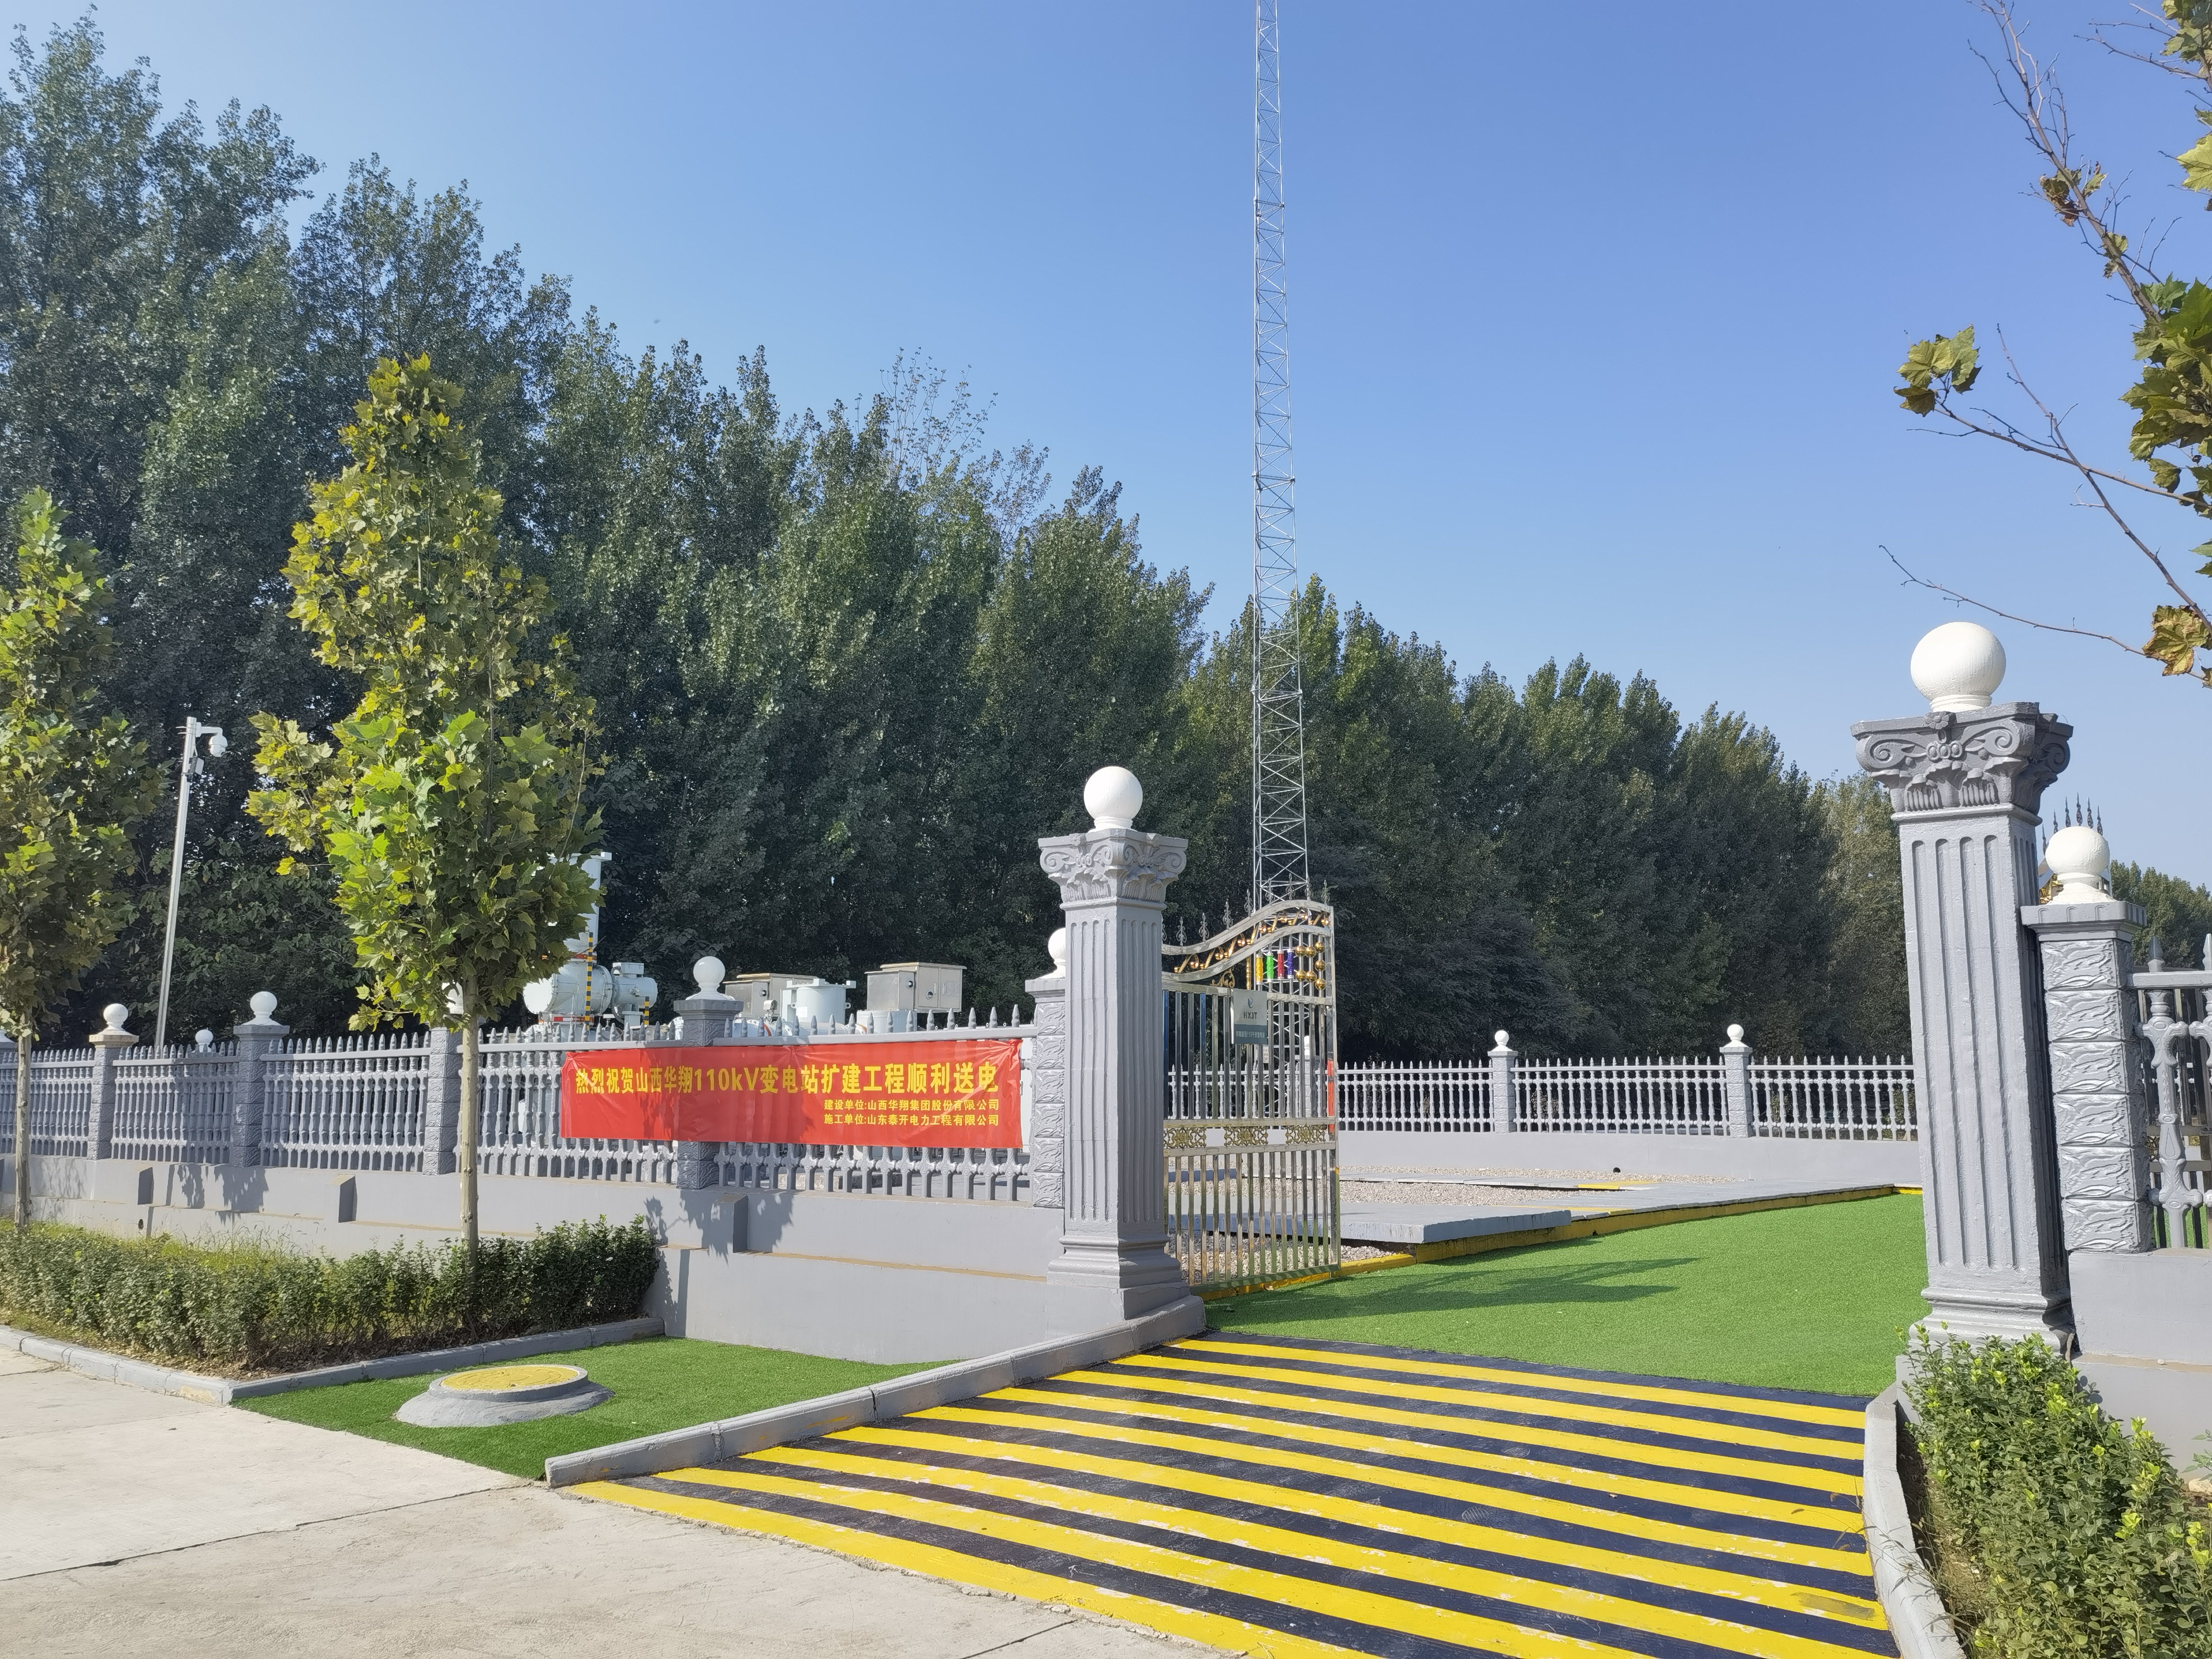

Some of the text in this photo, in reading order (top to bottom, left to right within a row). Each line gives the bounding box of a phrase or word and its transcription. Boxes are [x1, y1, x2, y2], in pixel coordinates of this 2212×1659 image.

[1243, 1011, 1257, 1020] HXJT
[575, 1061, 999, 1094] 热烈祝贺山西华翔110kV变电站扩建工程顺利送电
